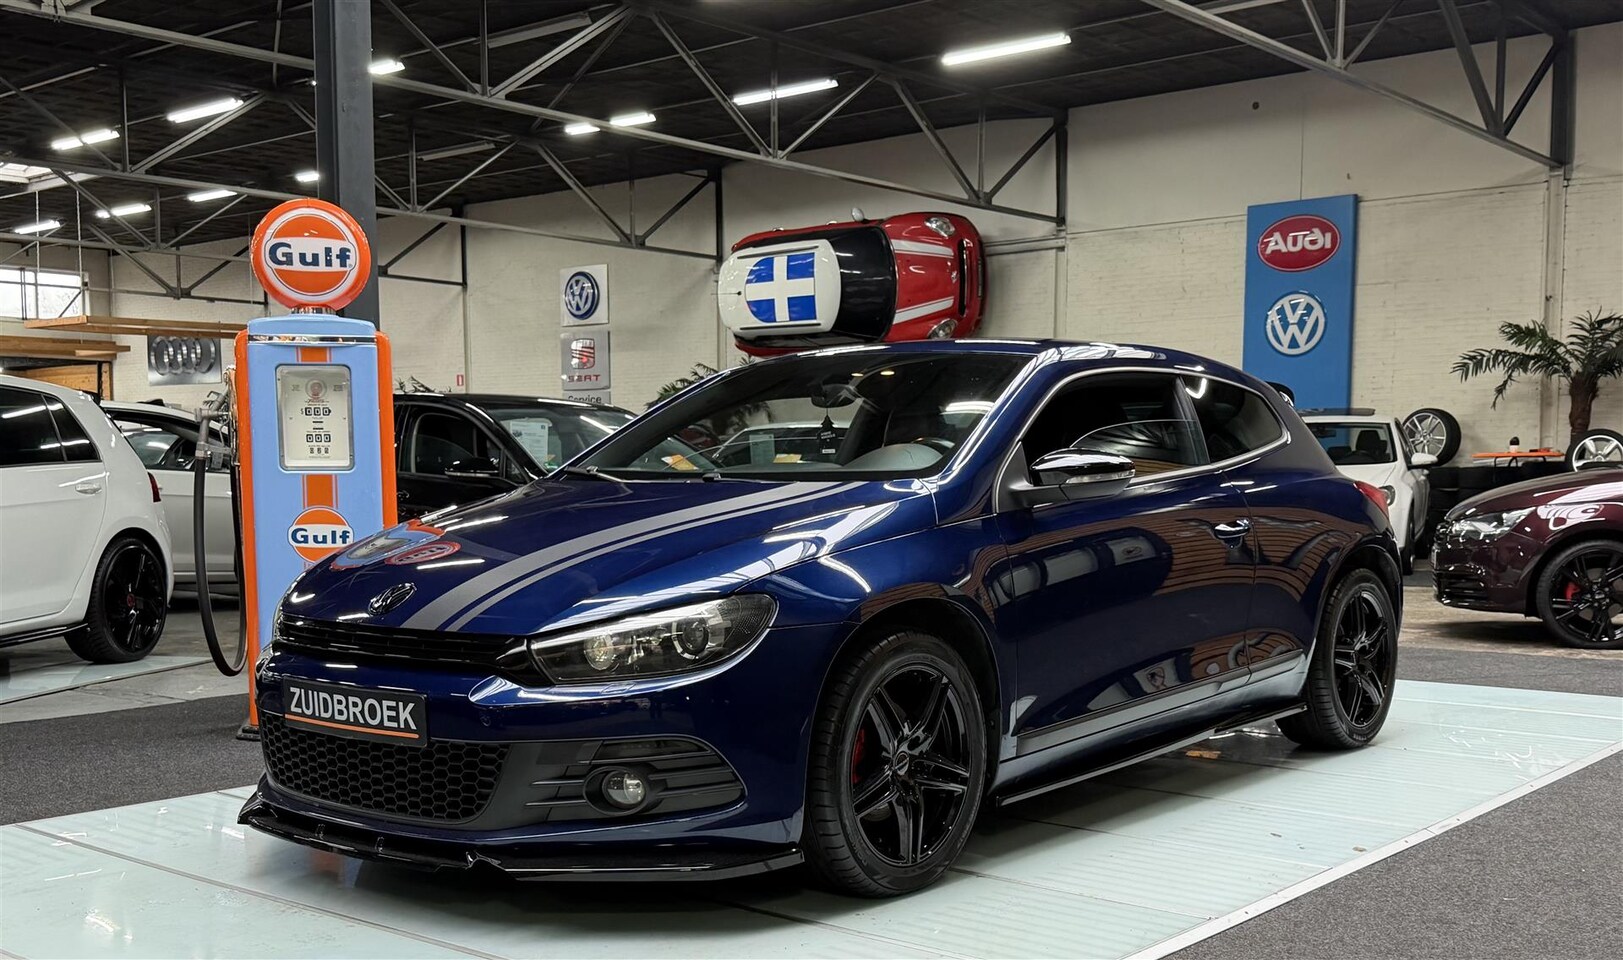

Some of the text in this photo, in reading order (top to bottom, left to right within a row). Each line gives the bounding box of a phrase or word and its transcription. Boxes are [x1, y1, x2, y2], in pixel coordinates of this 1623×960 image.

[268, 242, 351, 268] Gulf
[567, 374, 601, 383] SEAT
[291, 527, 351, 545] Gulf
[289, 686, 418, 730] ZUIDBROEK
